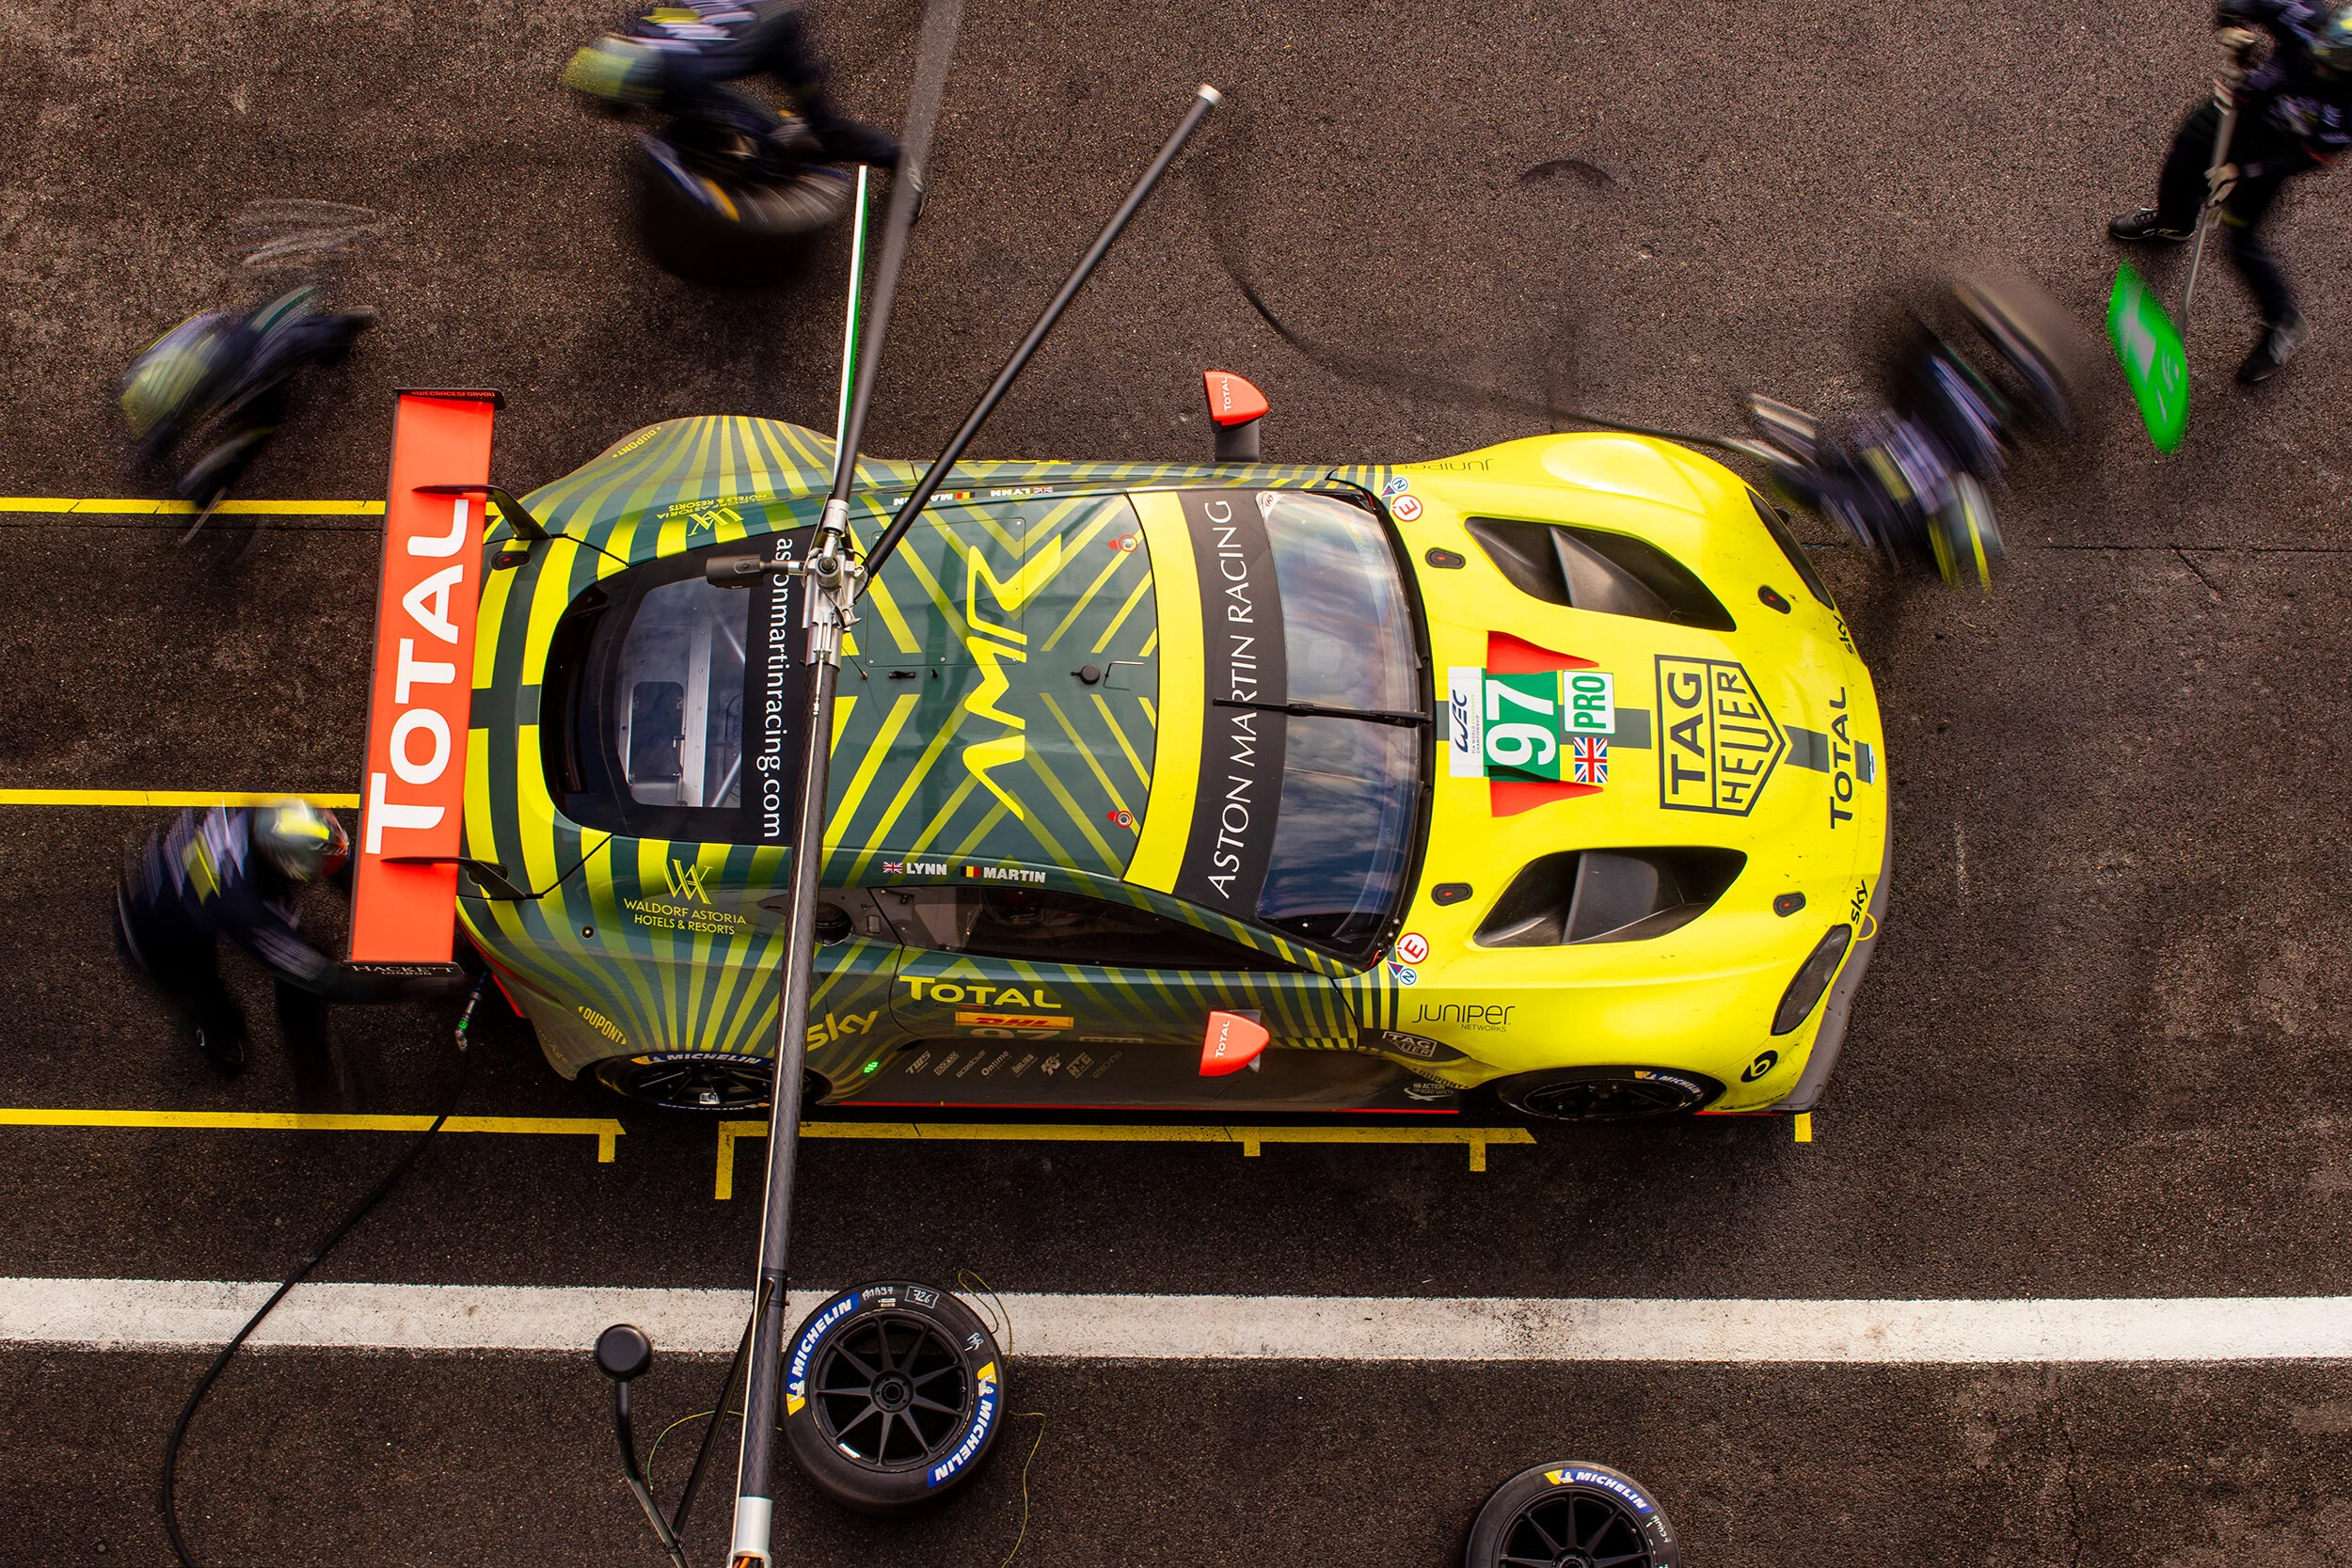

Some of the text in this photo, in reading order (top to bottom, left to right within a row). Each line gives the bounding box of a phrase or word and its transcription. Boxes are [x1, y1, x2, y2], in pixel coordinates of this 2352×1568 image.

[1221, 377, 1232, 411] TOTAL
[618, 429, 657, 456] DUPONT
[893, 493, 954, 506] MAIN
[990, 487, 1030, 498] LYNN
[1398, 499, 1419, 516] E
[365, 499, 469, 854] TOTAL
[756, 538, 793, 838] asonmartinracing.com
[1204, 500, 1258, 899] ASTON MARTIN RACING
[1572, 675, 1606, 729] PRO
[1452, 689, 1469, 752] WEC
[1486, 679, 1556, 766] 97
[1667, 672, 1706, 795] TAG
[1717, 672, 1774, 804] HEUER
[1829, 686, 1853, 830] TOTAL
[906, 863, 947, 876] LYNN
[983, 866, 1046, 883] MARTIN
[623, 897, 747, 926] WALDORF ASTORIA
[634, 913, 736, 936] HOTELS & RESORTS
[1404, 939, 1424, 959] E
[898, 975, 1062, 1008] TOTAL
[581, 1007, 623, 1044] DUPONT
[975, 1017, 1049, 1027] DHL
[1460, 1023, 1507, 1033] NETWORKS
[1215, 1021, 1230, 1057] TOTAL
[1386, 1033, 1431, 1049] TAG
[666, 1053, 762, 1065] MICHELIN
[981, 1051, 1009, 1076] Ontime
[913, 1289, 933, 1304] 726
[791, 1299, 851, 1377] MICHELIN
[934, 1399, 993, 1481] MICHELIN
[1576, 1471, 1647, 1510] MICHELIN
